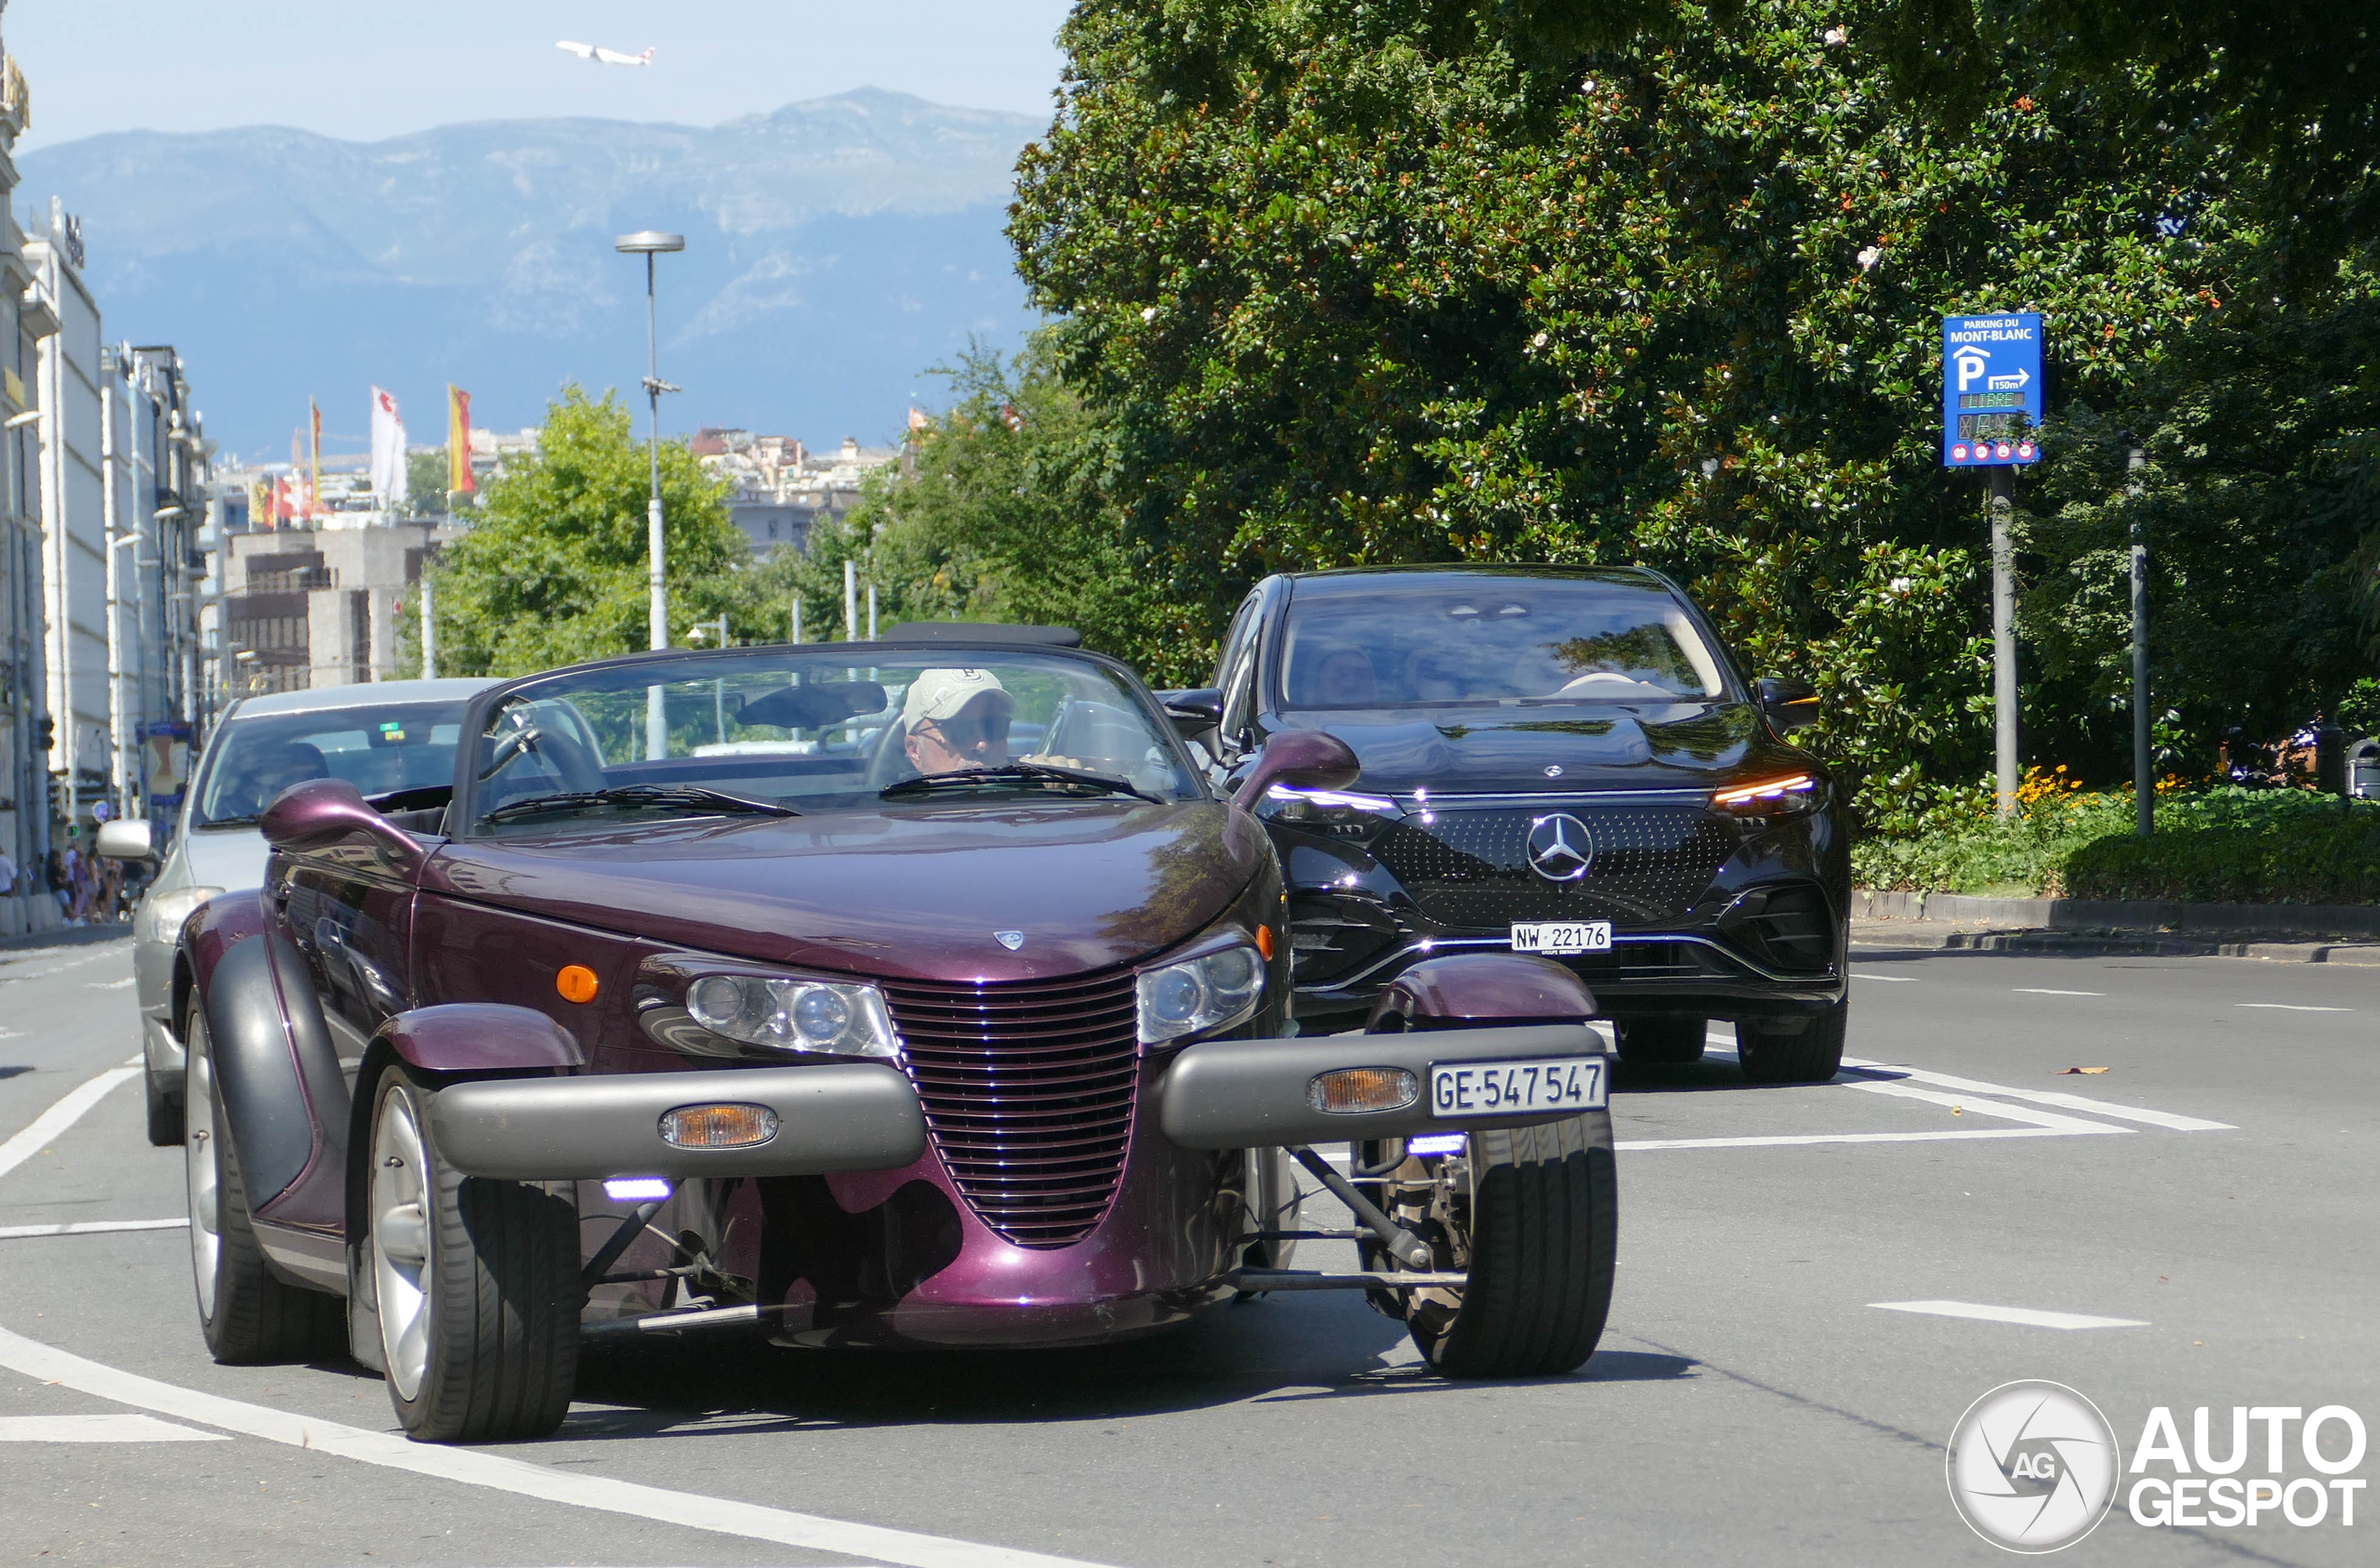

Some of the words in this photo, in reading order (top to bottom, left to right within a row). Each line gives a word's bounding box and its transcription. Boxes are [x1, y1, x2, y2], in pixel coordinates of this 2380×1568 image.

[1964, 320, 2003, 329] PARKING
[2005, 319, 2019, 327] DU
[1950, 328, 2032, 343] MONT-BLANC
[1958, 356, 1985, 391] P
[1994, 380, 2019, 389] 150m
[1968, 392, 2015, 409] LIBRE
[1516, 929, 1540, 947] NW
[1552, 927, 1605, 946] 22176
